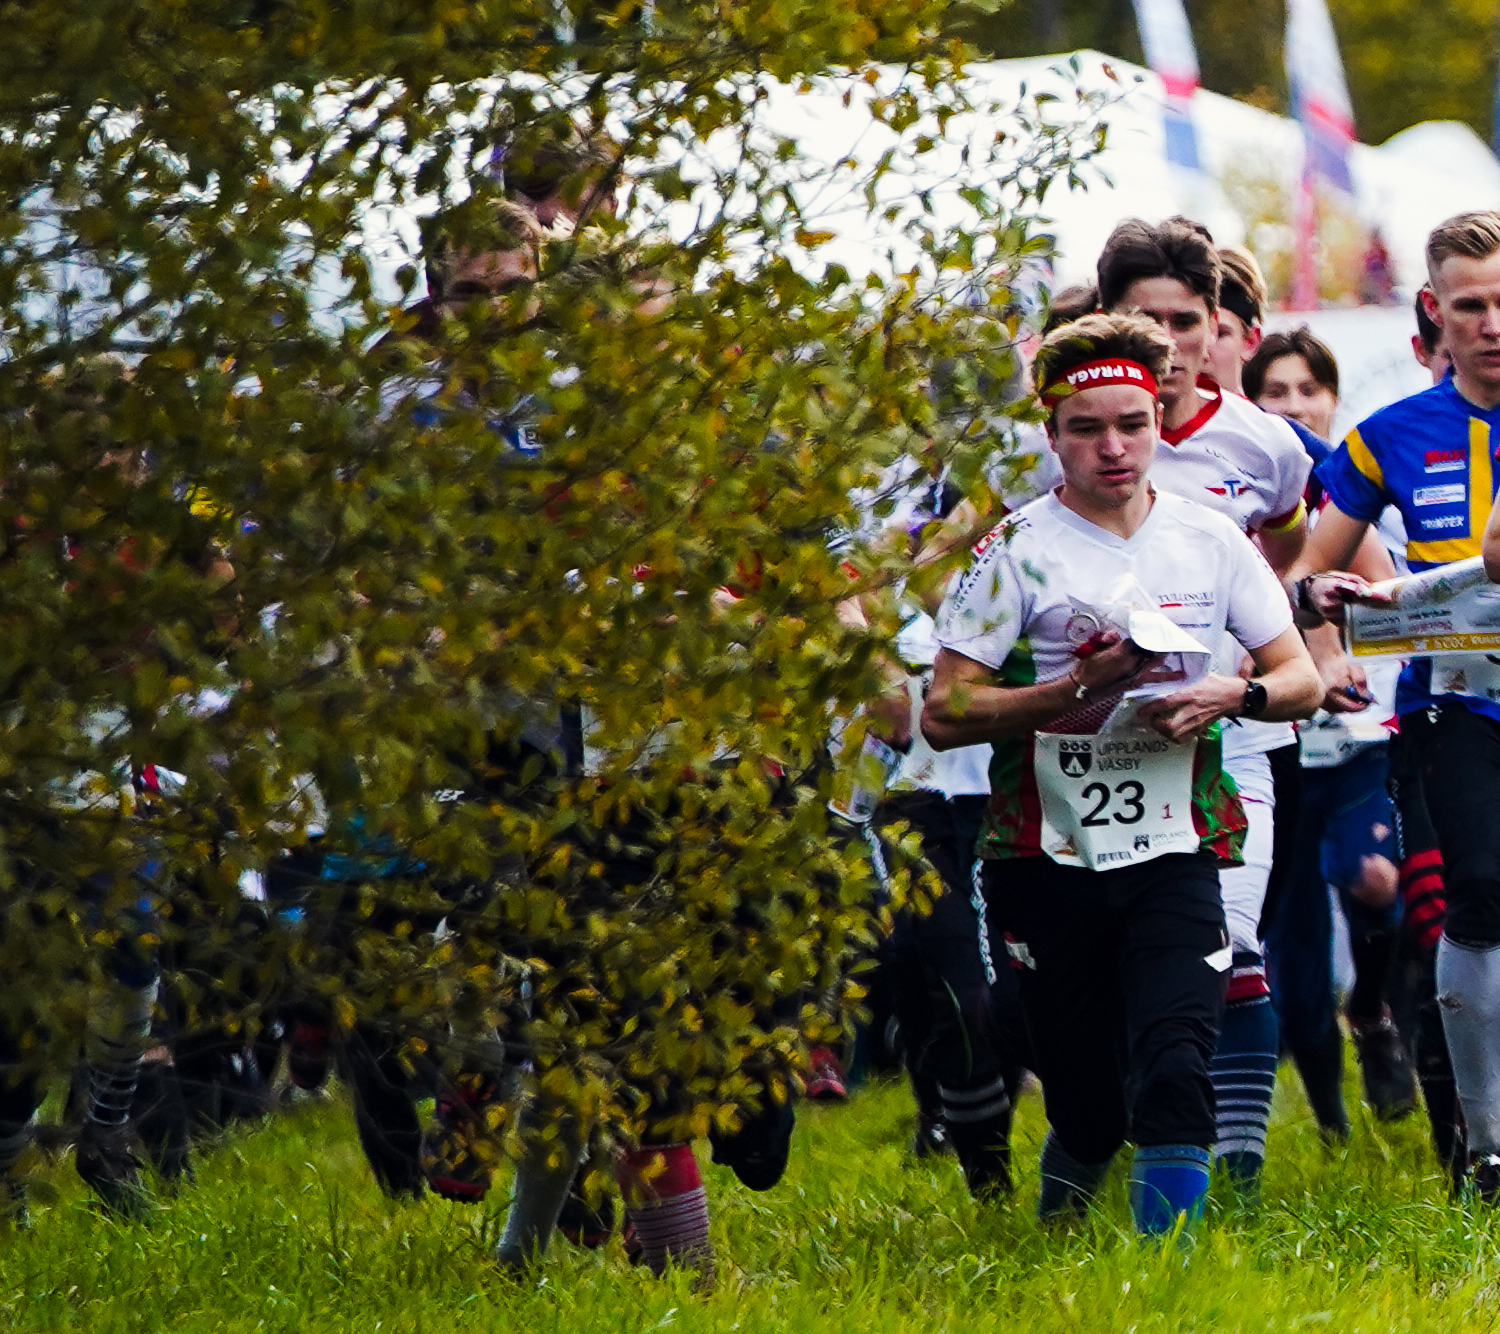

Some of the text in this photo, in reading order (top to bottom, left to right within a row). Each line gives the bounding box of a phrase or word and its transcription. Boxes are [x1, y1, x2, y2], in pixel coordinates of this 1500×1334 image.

[1067, 365, 1124, 385] PRAGA
[1097, 741, 1169, 756] UPPLANDS
[1096, 758, 1142, 771] VÄSBY
[1081, 780, 1173, 827] 23 1
